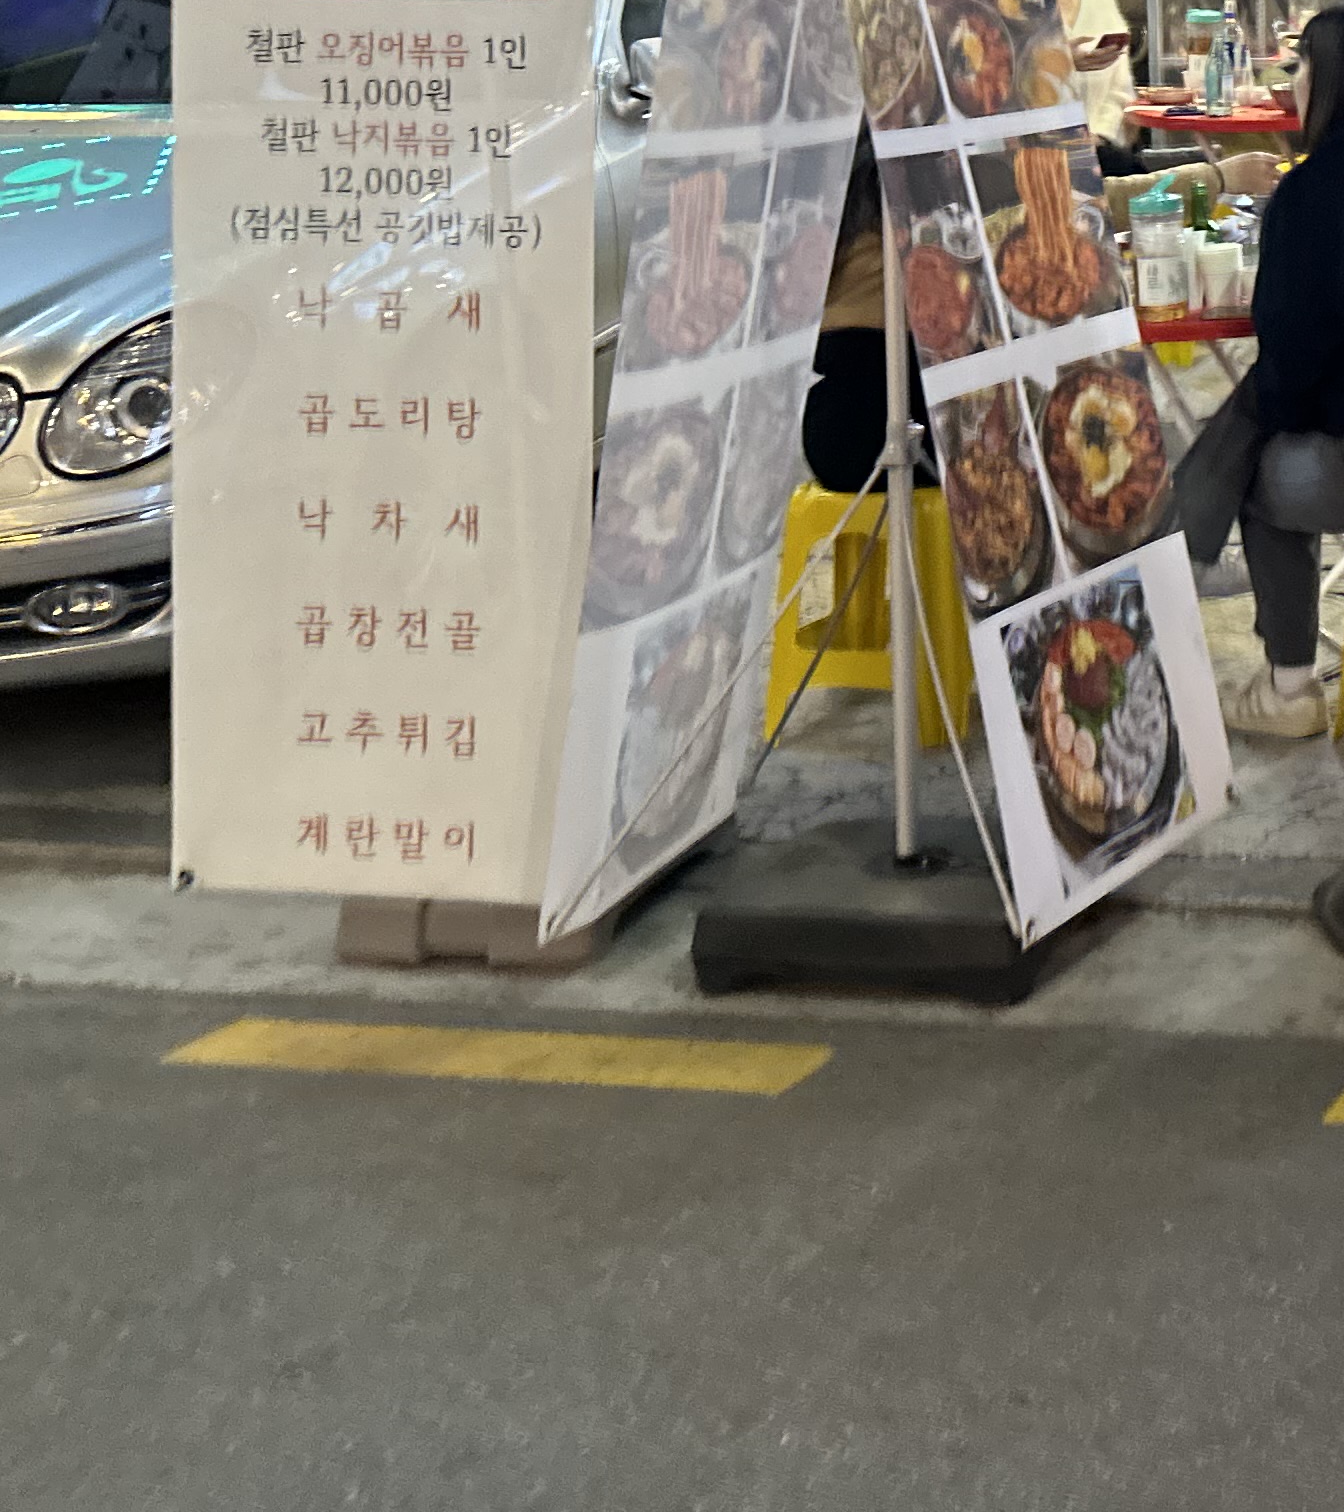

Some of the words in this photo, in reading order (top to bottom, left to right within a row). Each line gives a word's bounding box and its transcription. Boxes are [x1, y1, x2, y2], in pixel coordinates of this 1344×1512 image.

[246, 28, 305, 65] 철판
[316, 32, 469, 70] 오징어볶음
[483, 34, 526, 70] 1인
[320, 78, 452, 113] 11,000원
[262, 118, 319, 154] 철판
[332, 120, 454, 158] 낙지볶음
[467, 124, 512, 159] 1인
[320, 166, 453, 202] 12,000원
[231, 206, 363, 245] (점심특선
